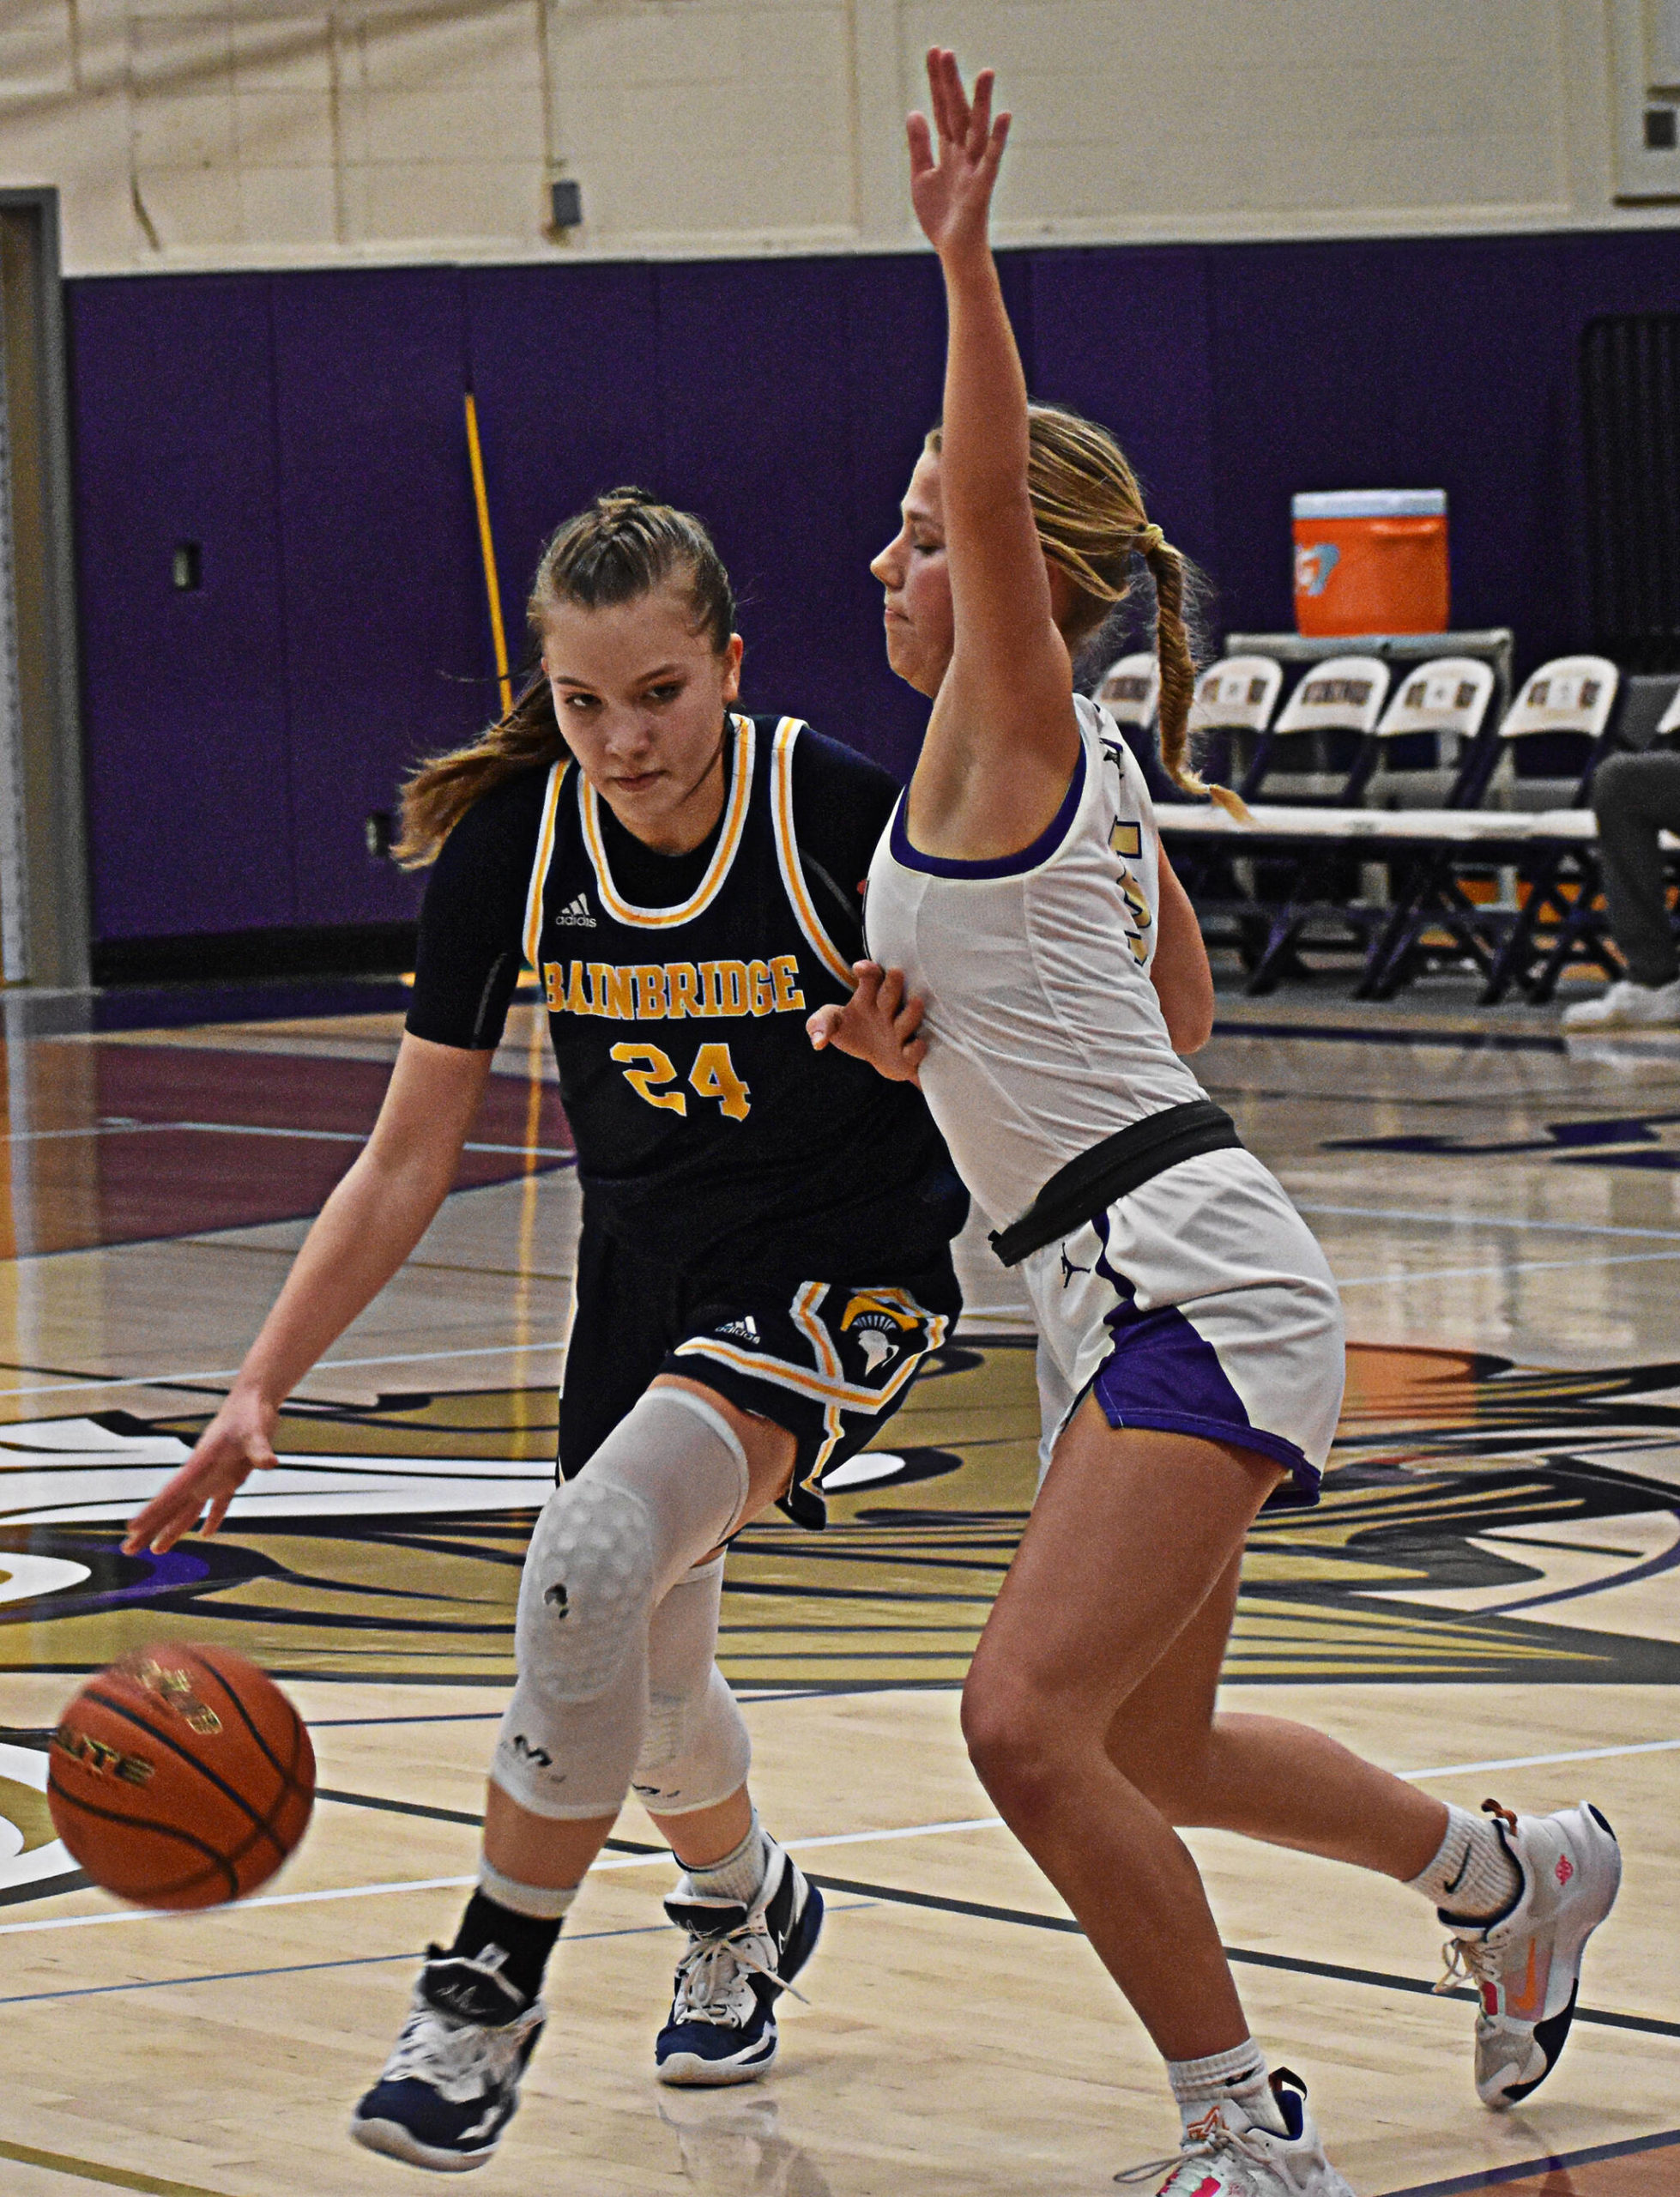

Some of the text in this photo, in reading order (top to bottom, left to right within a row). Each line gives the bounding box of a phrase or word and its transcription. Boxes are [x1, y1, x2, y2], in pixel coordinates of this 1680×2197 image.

[555, 913, 596, 928] adidas
[543, 954, 807, 1020] BAINBRIDGE
[609, 1041, 752, 1122] 24
